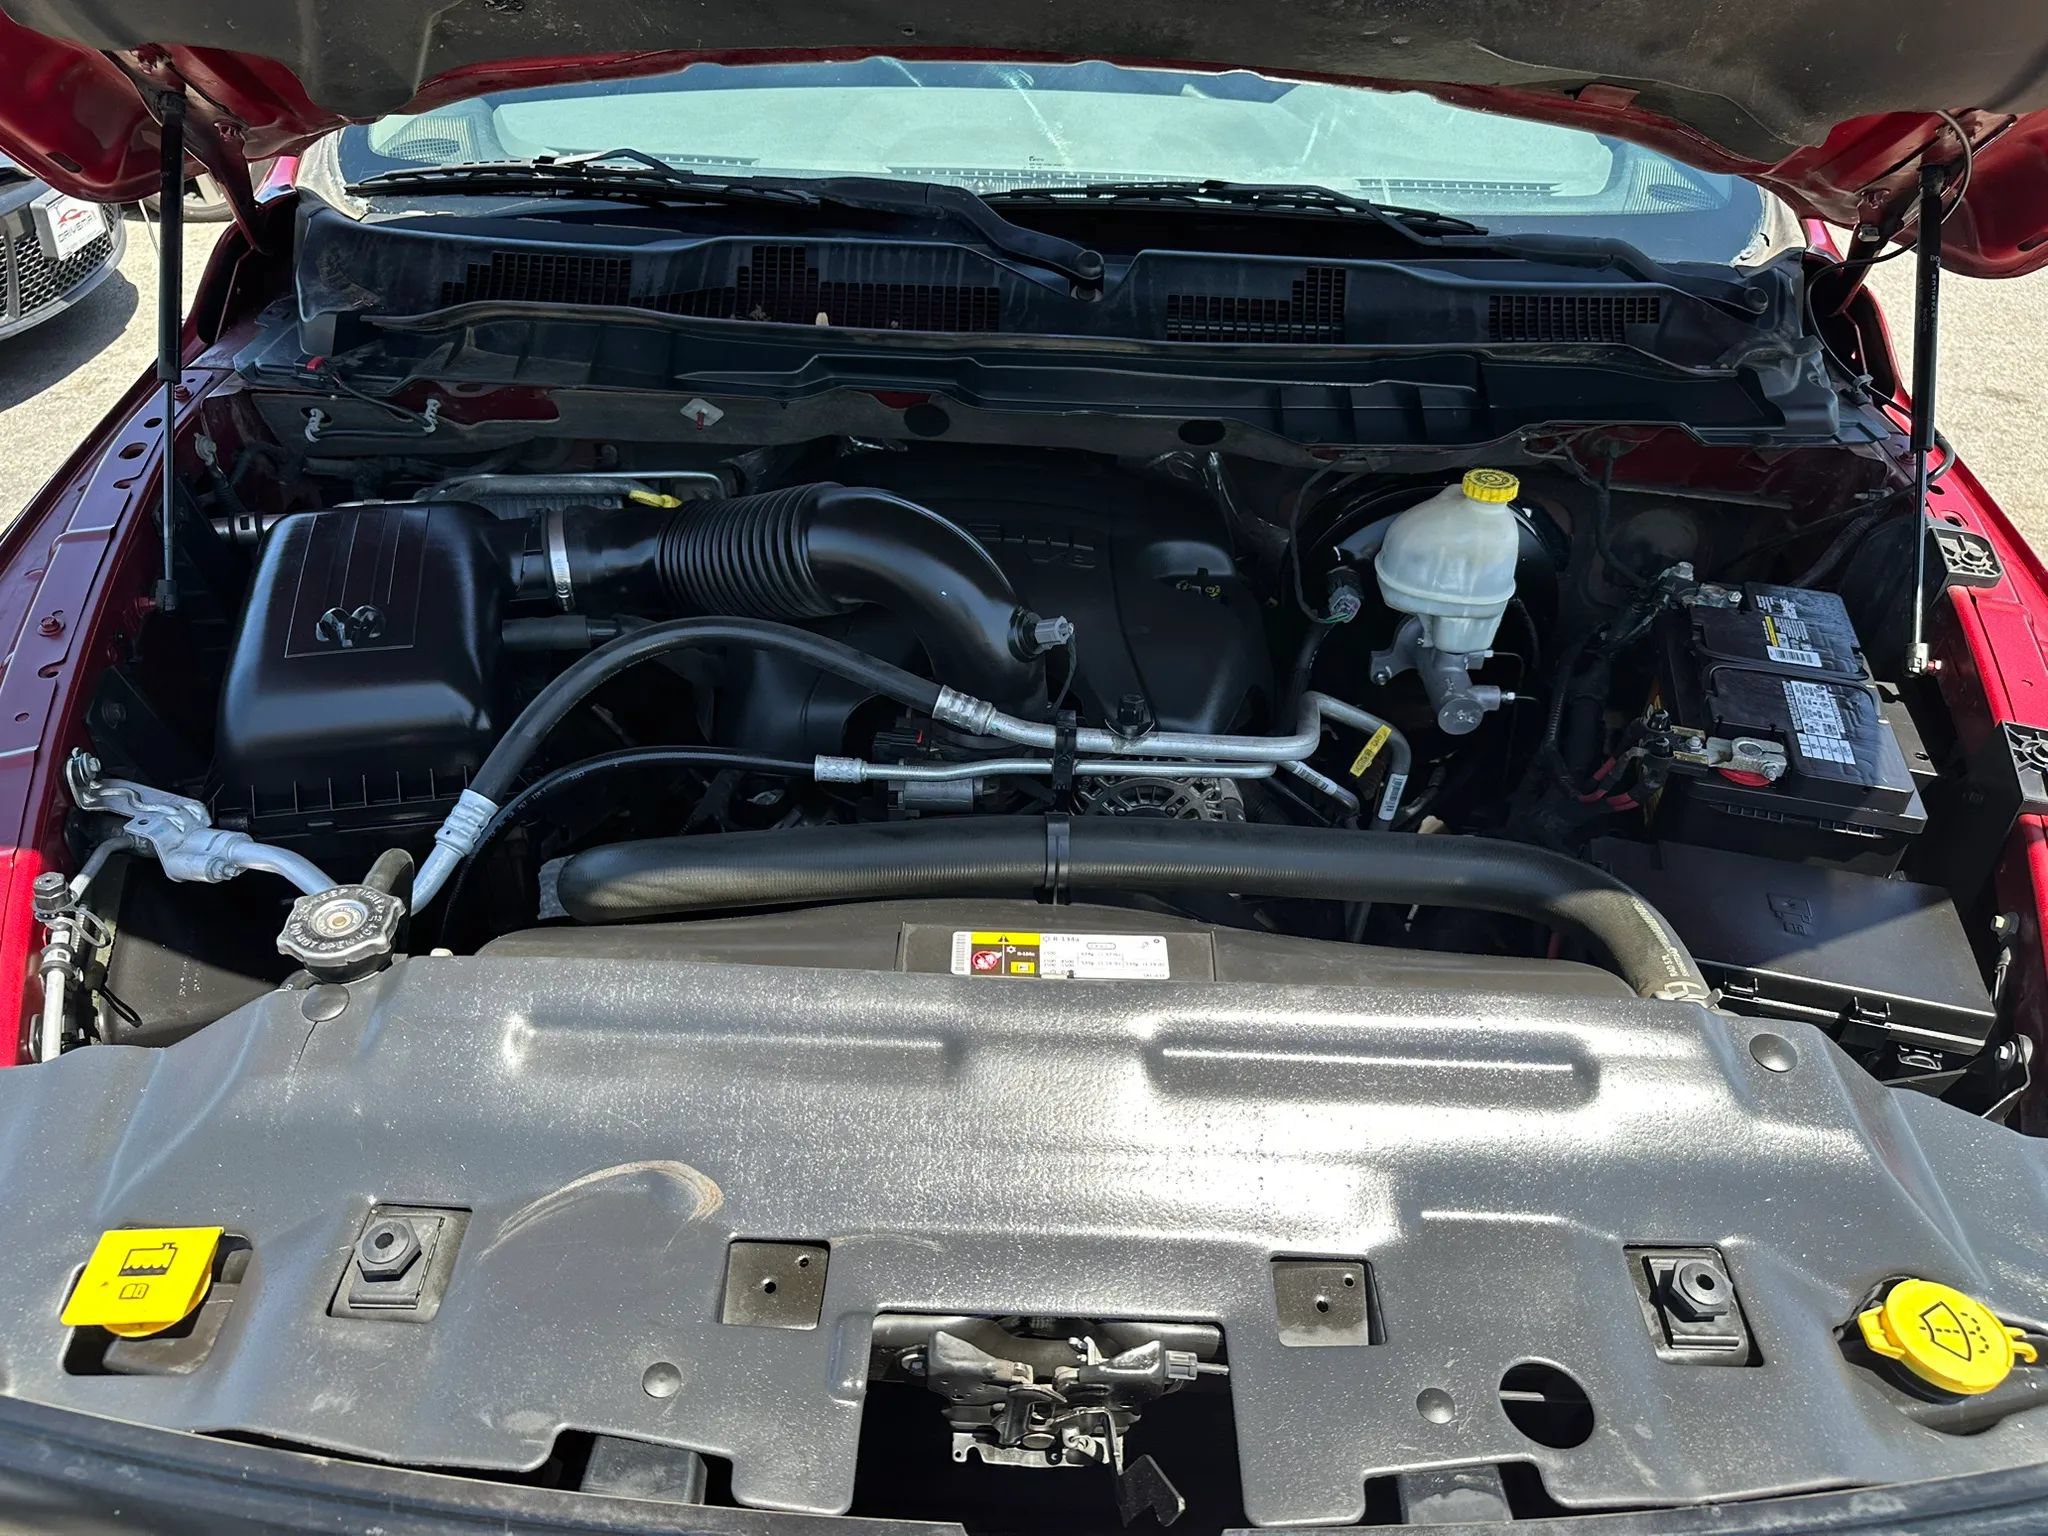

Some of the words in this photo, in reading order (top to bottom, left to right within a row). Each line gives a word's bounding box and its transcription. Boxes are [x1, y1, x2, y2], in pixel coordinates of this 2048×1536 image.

[290, 922, 304, 936] DO
[294, 933, 319, 948] NOT
[317, 937, 355, 949] OPEN
